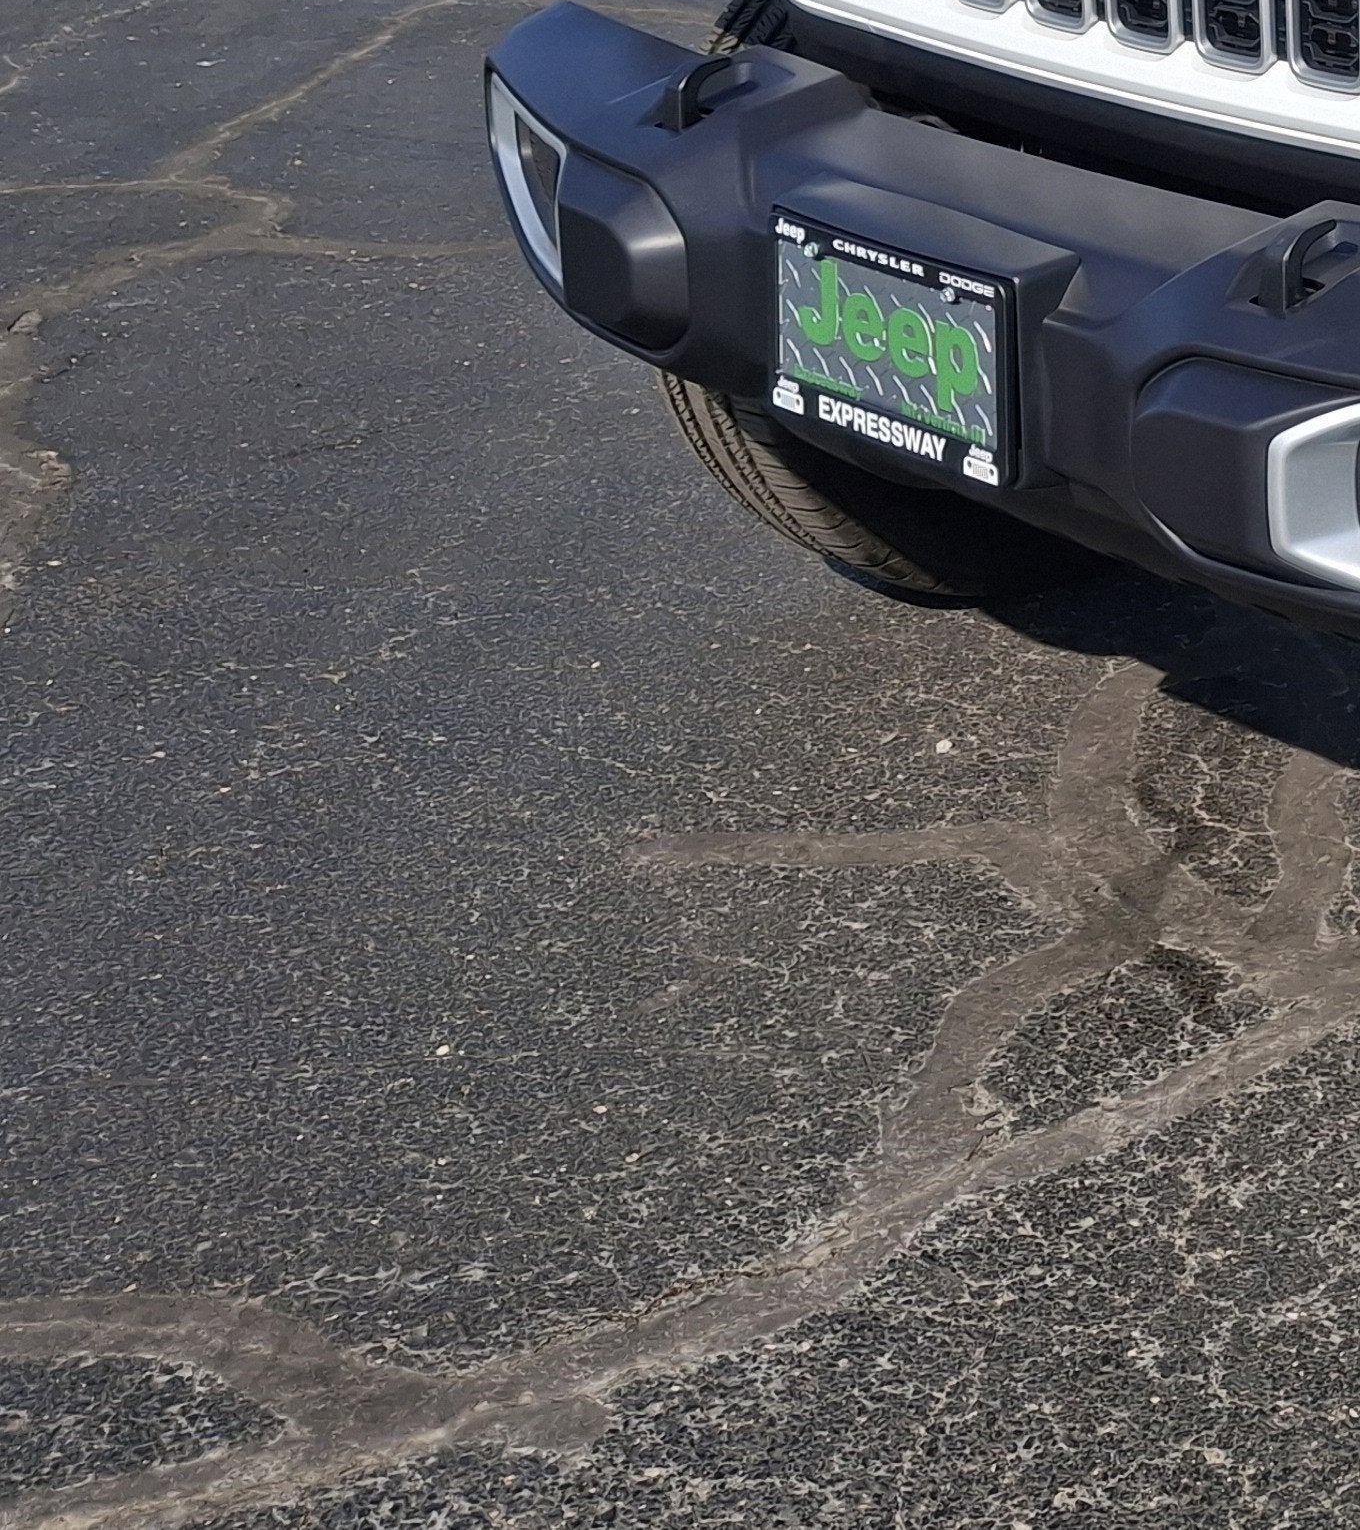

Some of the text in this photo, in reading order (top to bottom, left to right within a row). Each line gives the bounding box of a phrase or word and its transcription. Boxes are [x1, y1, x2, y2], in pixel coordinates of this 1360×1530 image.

[775, 217, 995, 299] Jeep CHRYSLER DODGE
[799, 258, 979, 413] Jeep
[818, 394, 947, 462] EXPRESSWAY
